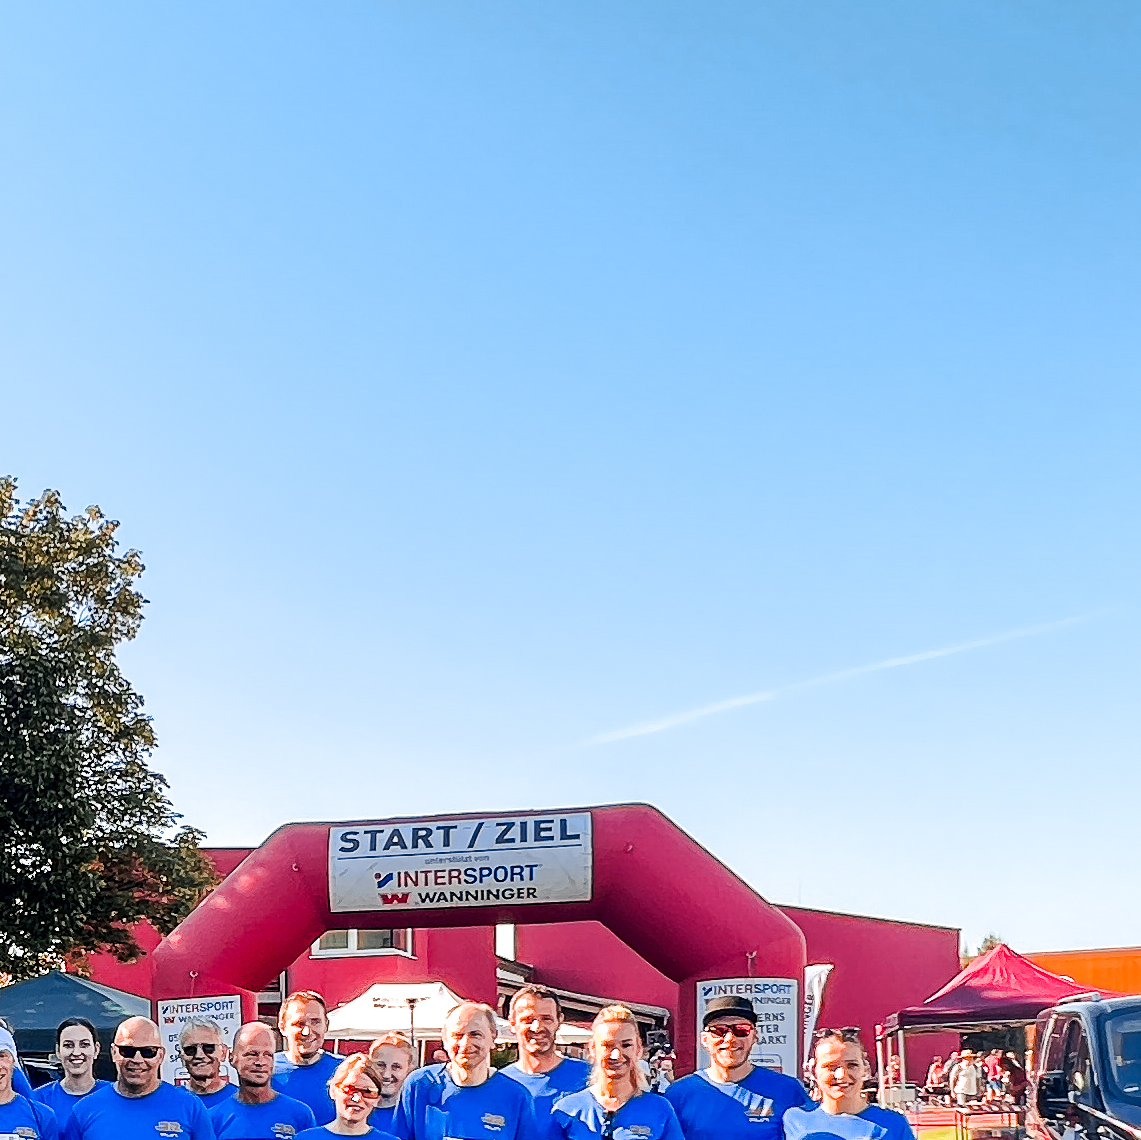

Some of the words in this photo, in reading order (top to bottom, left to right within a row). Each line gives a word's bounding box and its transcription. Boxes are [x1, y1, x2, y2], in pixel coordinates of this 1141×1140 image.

[338, 824, 458, 852] START
[467, 822, 485, 849] /
[494, 818, 581, 845] ZIEL
[396, 864, 539, 888] INTERSPORT
[418, 887, 538, 904] WANNINGER
[713, 984, 792, 996] INTERSPORT
[169, 1001, 235, 1015] INTERSPORT
